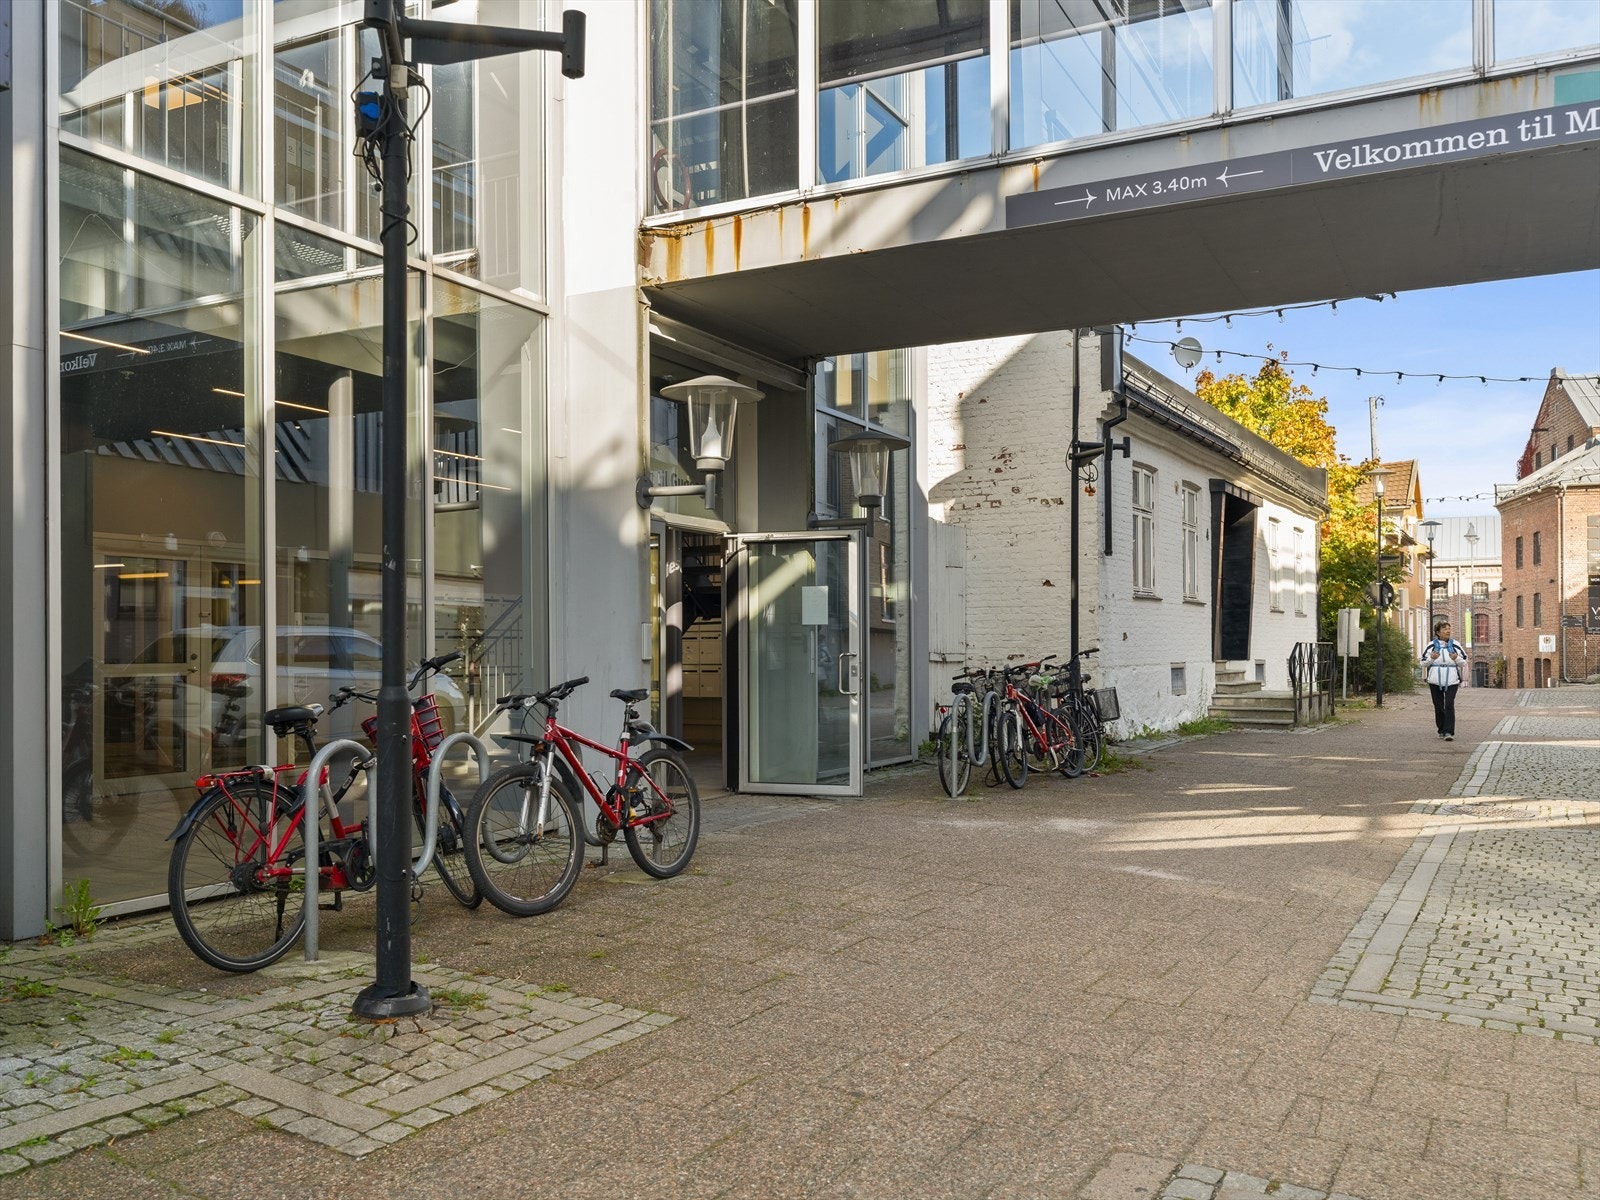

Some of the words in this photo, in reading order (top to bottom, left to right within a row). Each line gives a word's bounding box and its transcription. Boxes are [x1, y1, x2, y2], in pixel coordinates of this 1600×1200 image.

[1313, 127, 1509, 172] Velkommen
[1517, 115, 1556, 142] til
[1106, 182, 1148, 202] MAX
[1152, 175, 1208, 195] 3.40m
